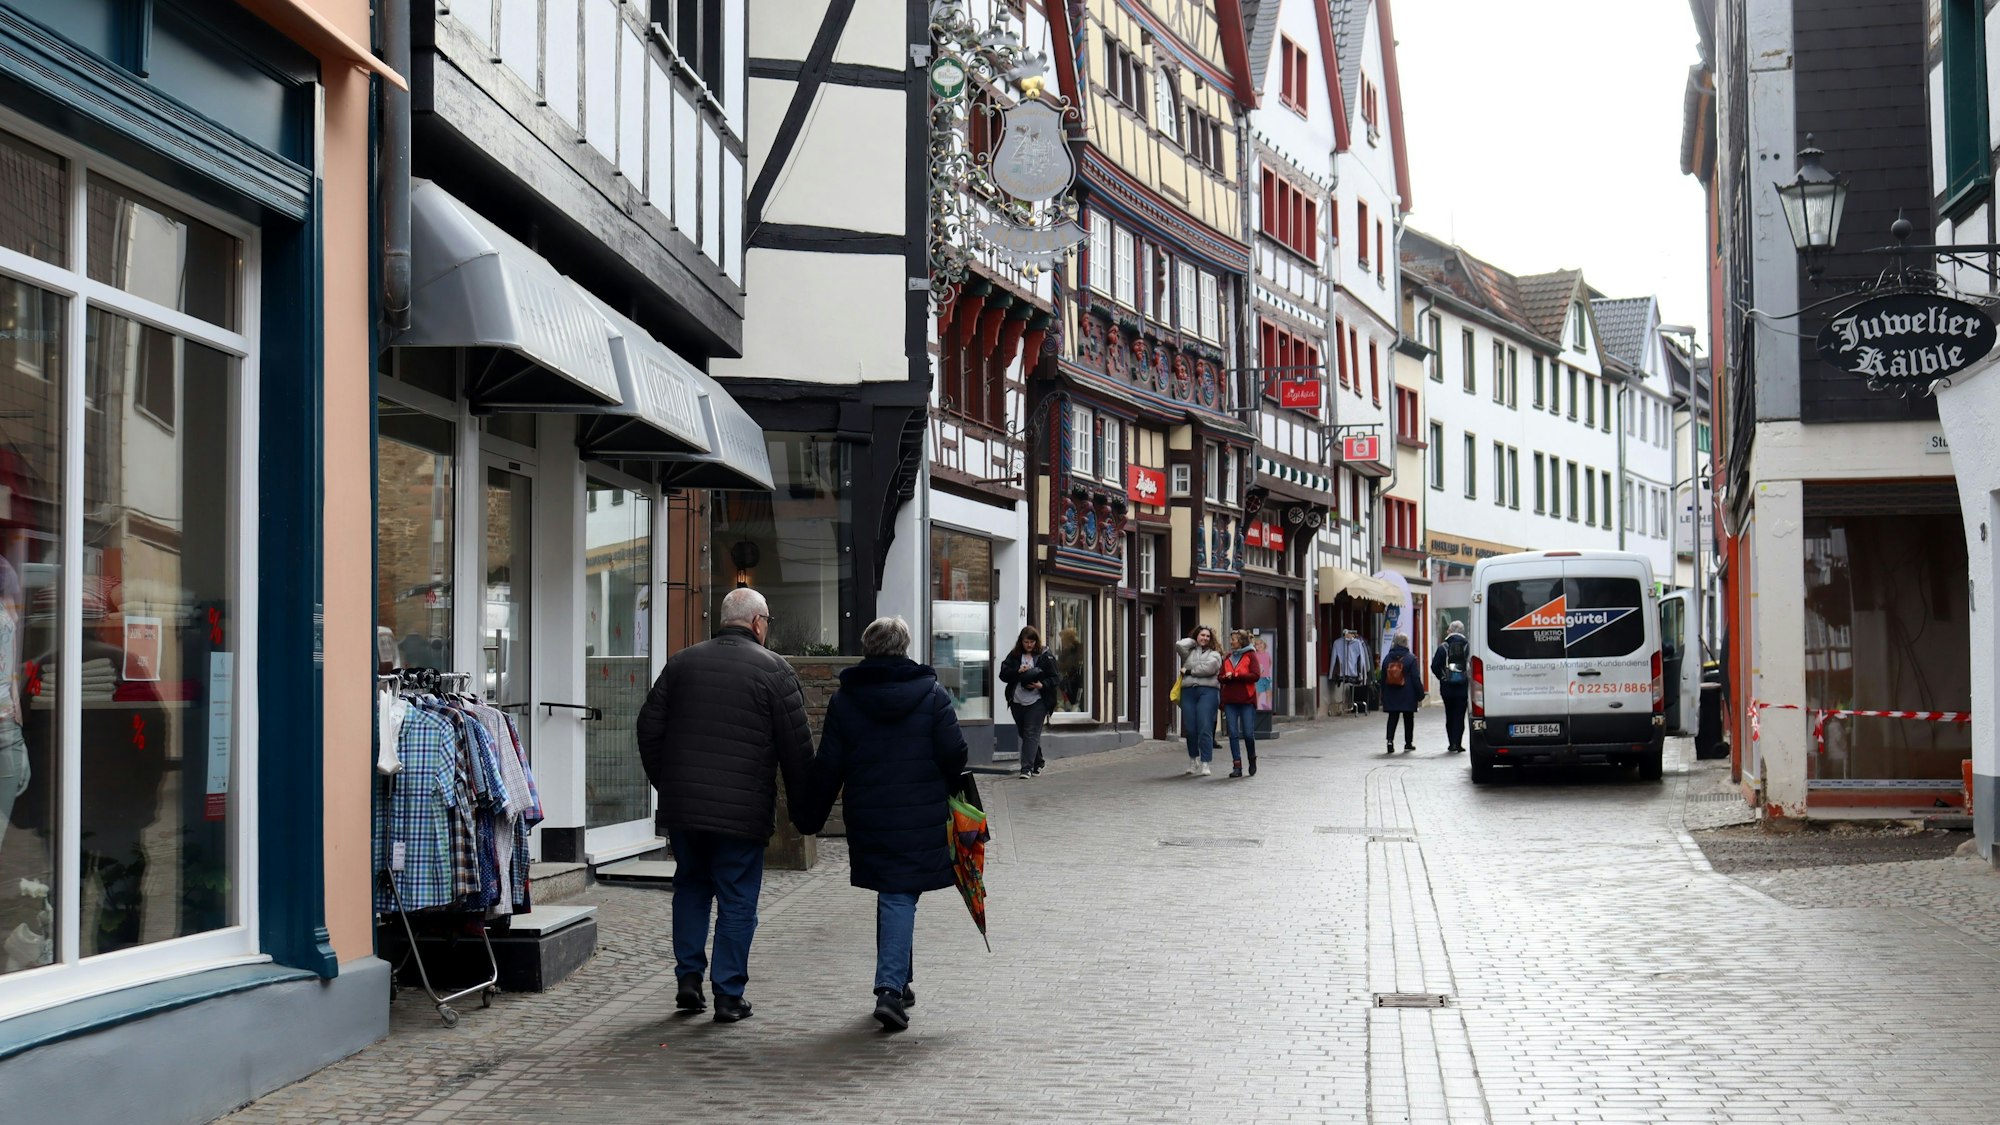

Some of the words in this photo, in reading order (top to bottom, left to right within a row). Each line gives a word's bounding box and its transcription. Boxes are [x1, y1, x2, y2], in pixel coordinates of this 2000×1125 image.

[1832, 306, 1981, 354] Juwelier
[1849, 343, 1965, 378] Kälble
[1531, 611, 1608, 627] Hochgürtel
[1486, 663, 1520, 671] Beratung
[1524, 662, 1556, 671] Planung
[1560, 661, 1593, 669] Montage
[1597, 659, 1649, 668] Kundendienst
